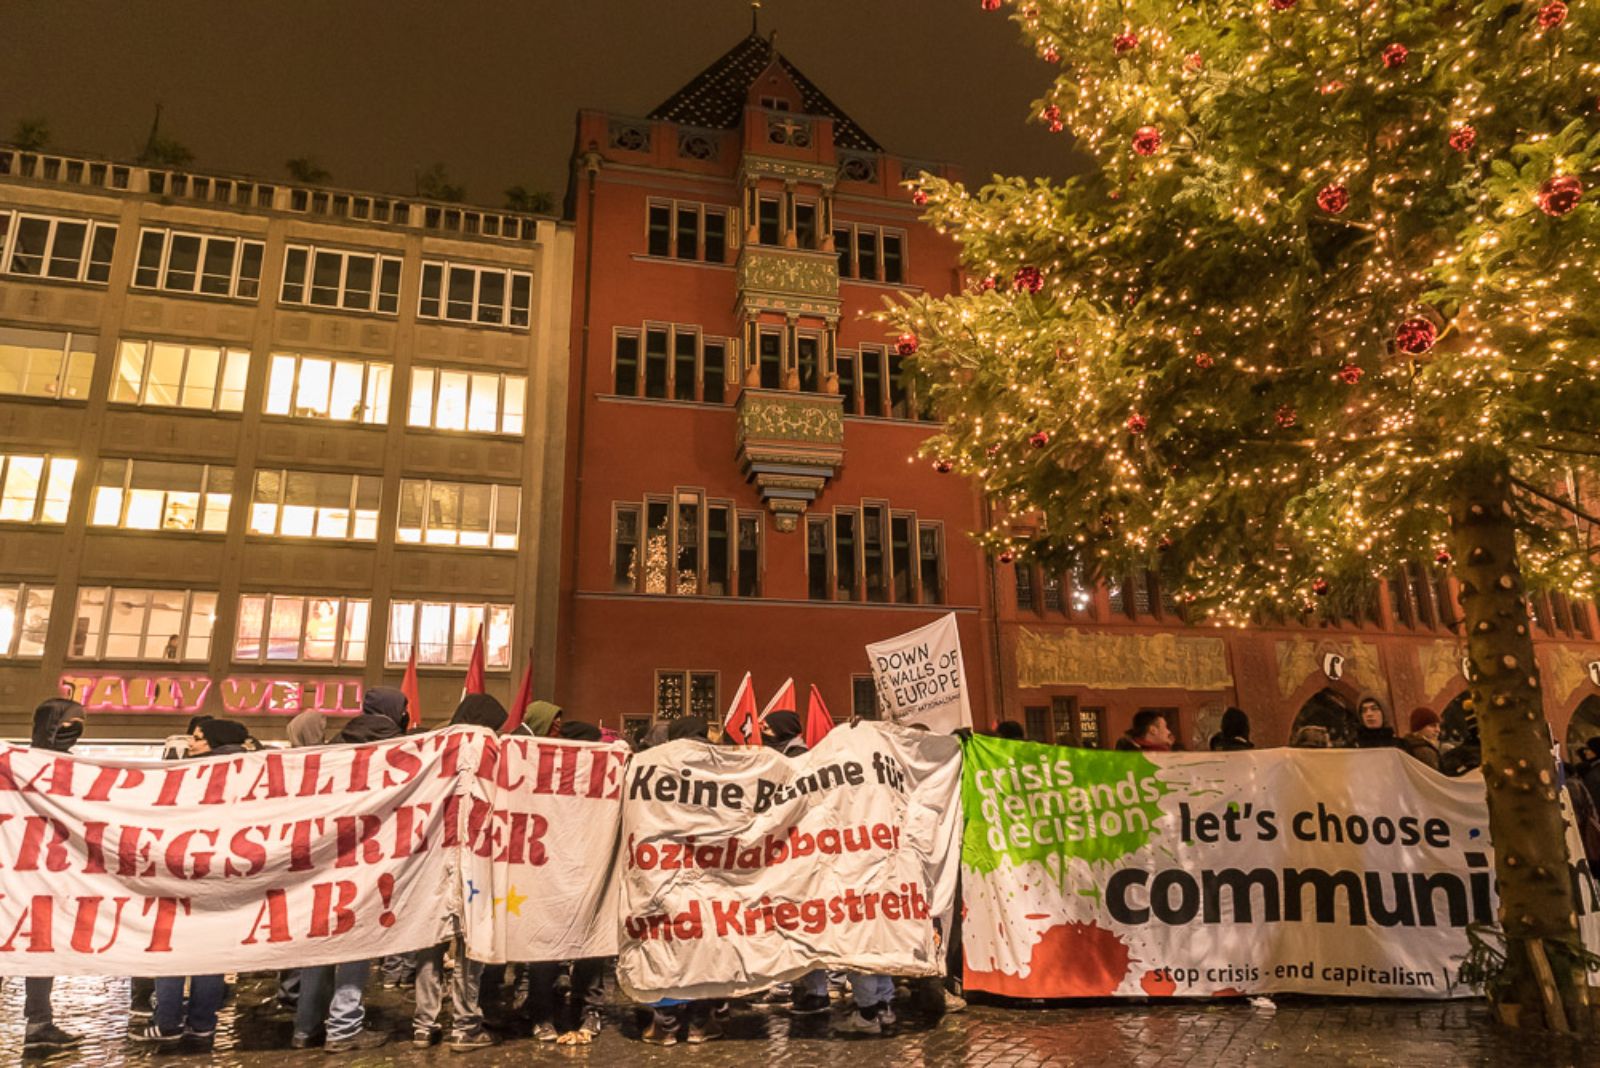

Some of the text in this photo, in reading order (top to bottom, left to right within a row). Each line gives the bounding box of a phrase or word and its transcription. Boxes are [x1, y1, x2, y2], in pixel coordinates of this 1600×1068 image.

[877, 643, 929, 673] DOWN
[889, 663, 935, 687] WALLS
[939, 649, 957, 669] OF
[61, 676, 211, 710] TALLY
[895, 670, 960, 707] EUROPE
[630, 765, 744, 810] Keine
[975, 754, 1074, 796] crisis
[981, 771, 1161, 825] demands
[0, 793, 549, 879] RIEGSTREIBER
[987, 806, 1150, 852] decision
[1178, 802, 1450, 848] let's choose
[0, 872, 396, 953] AUT AB!
[625, 900, 703, 941] und
[1153, 964, 1199, 987] stop
[1206, 964, 1259, 982] crisis
[1275, 961, 1314, 980] end
[1321, 963, 1435, 990] capitalism
